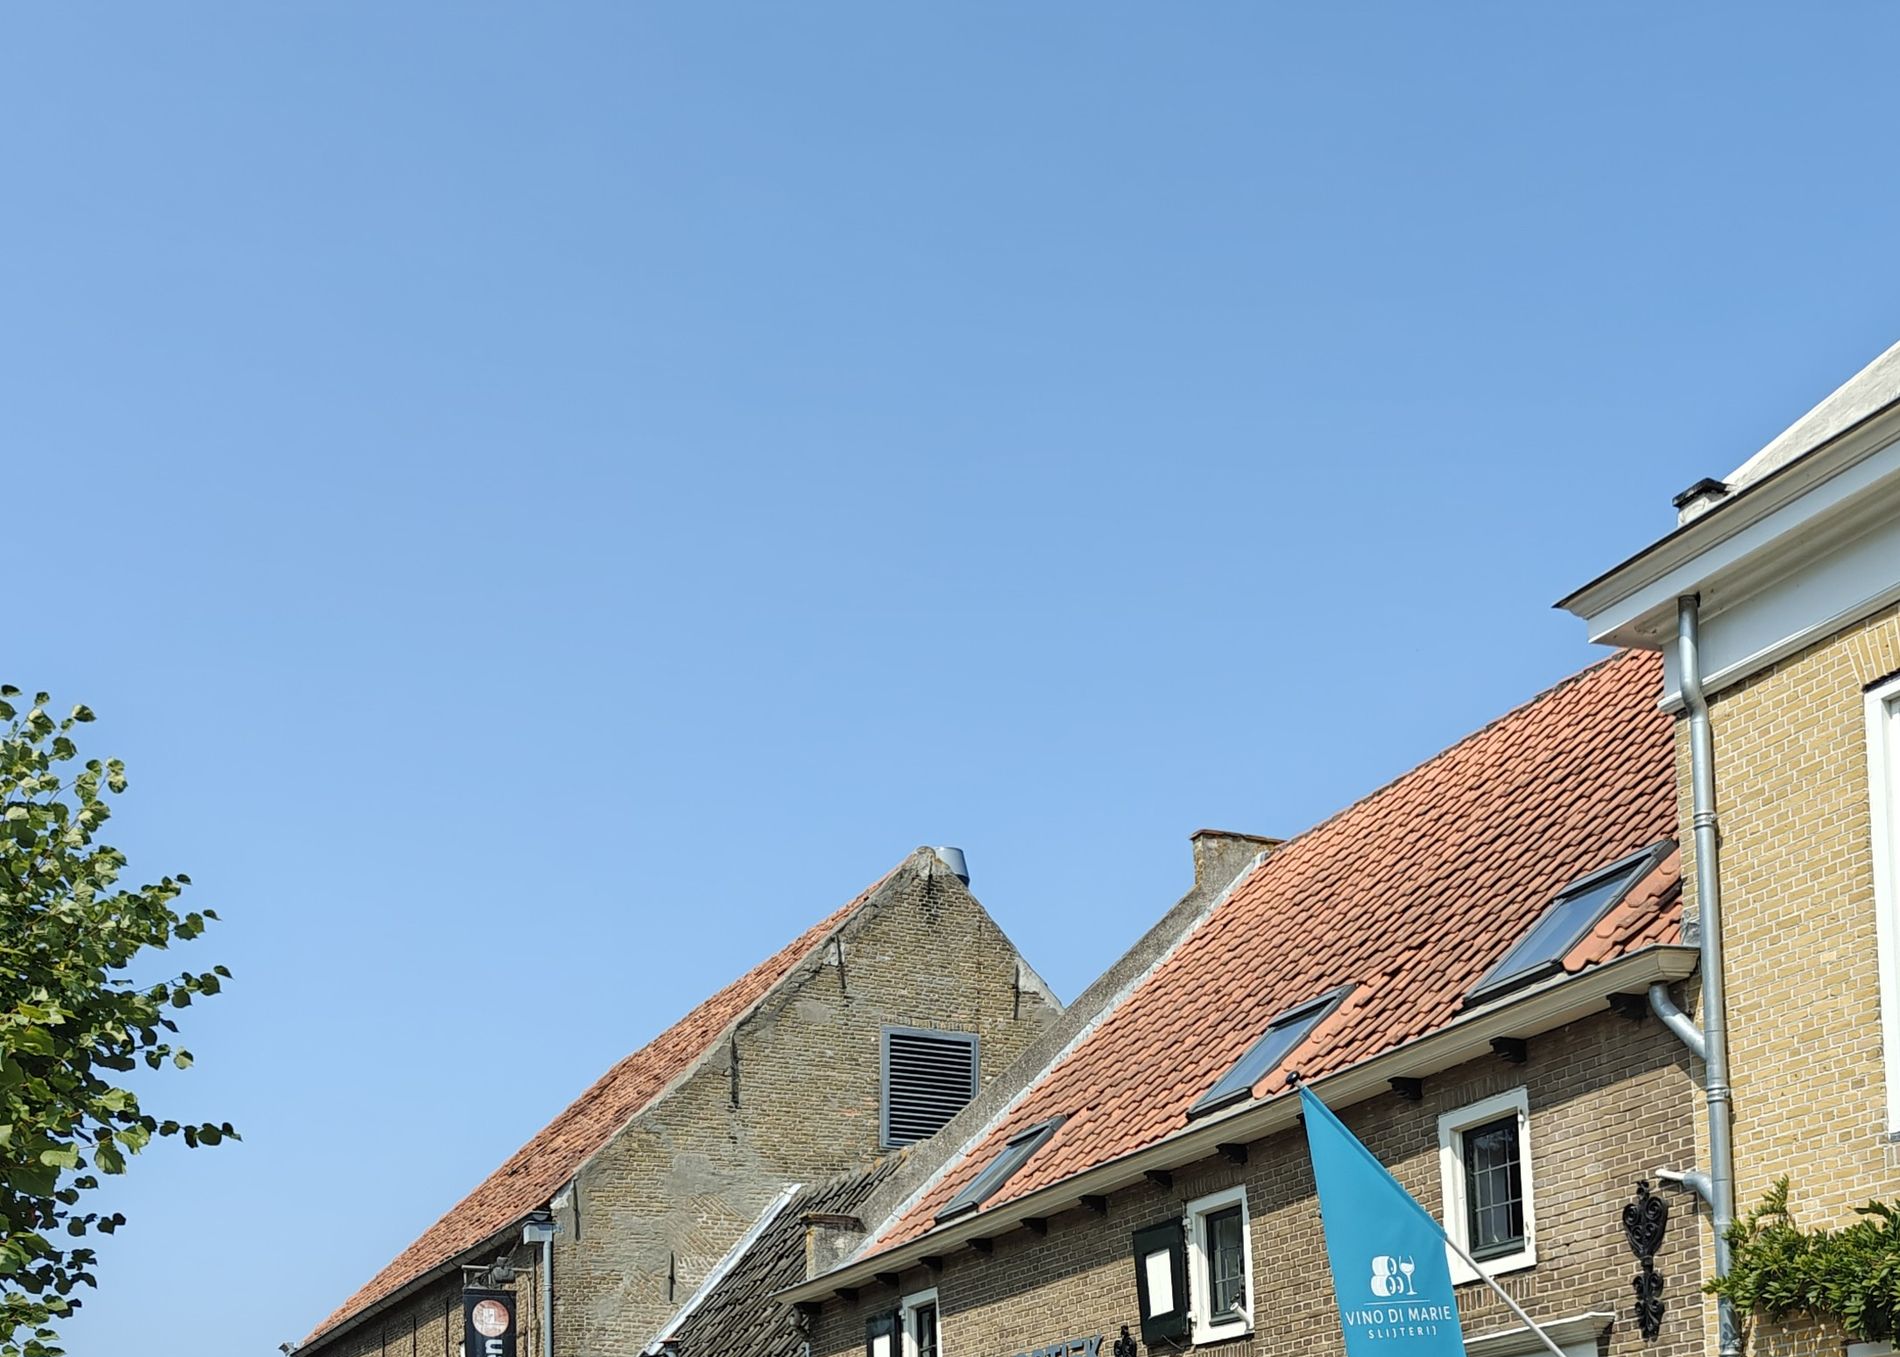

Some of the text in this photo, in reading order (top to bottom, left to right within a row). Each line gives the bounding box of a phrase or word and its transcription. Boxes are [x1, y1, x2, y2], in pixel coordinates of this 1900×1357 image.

[1345, 1306, 1452, 1326] VINO DI MARIE
[1368, 1326, 1437, 1340] SLIJTERIJ
